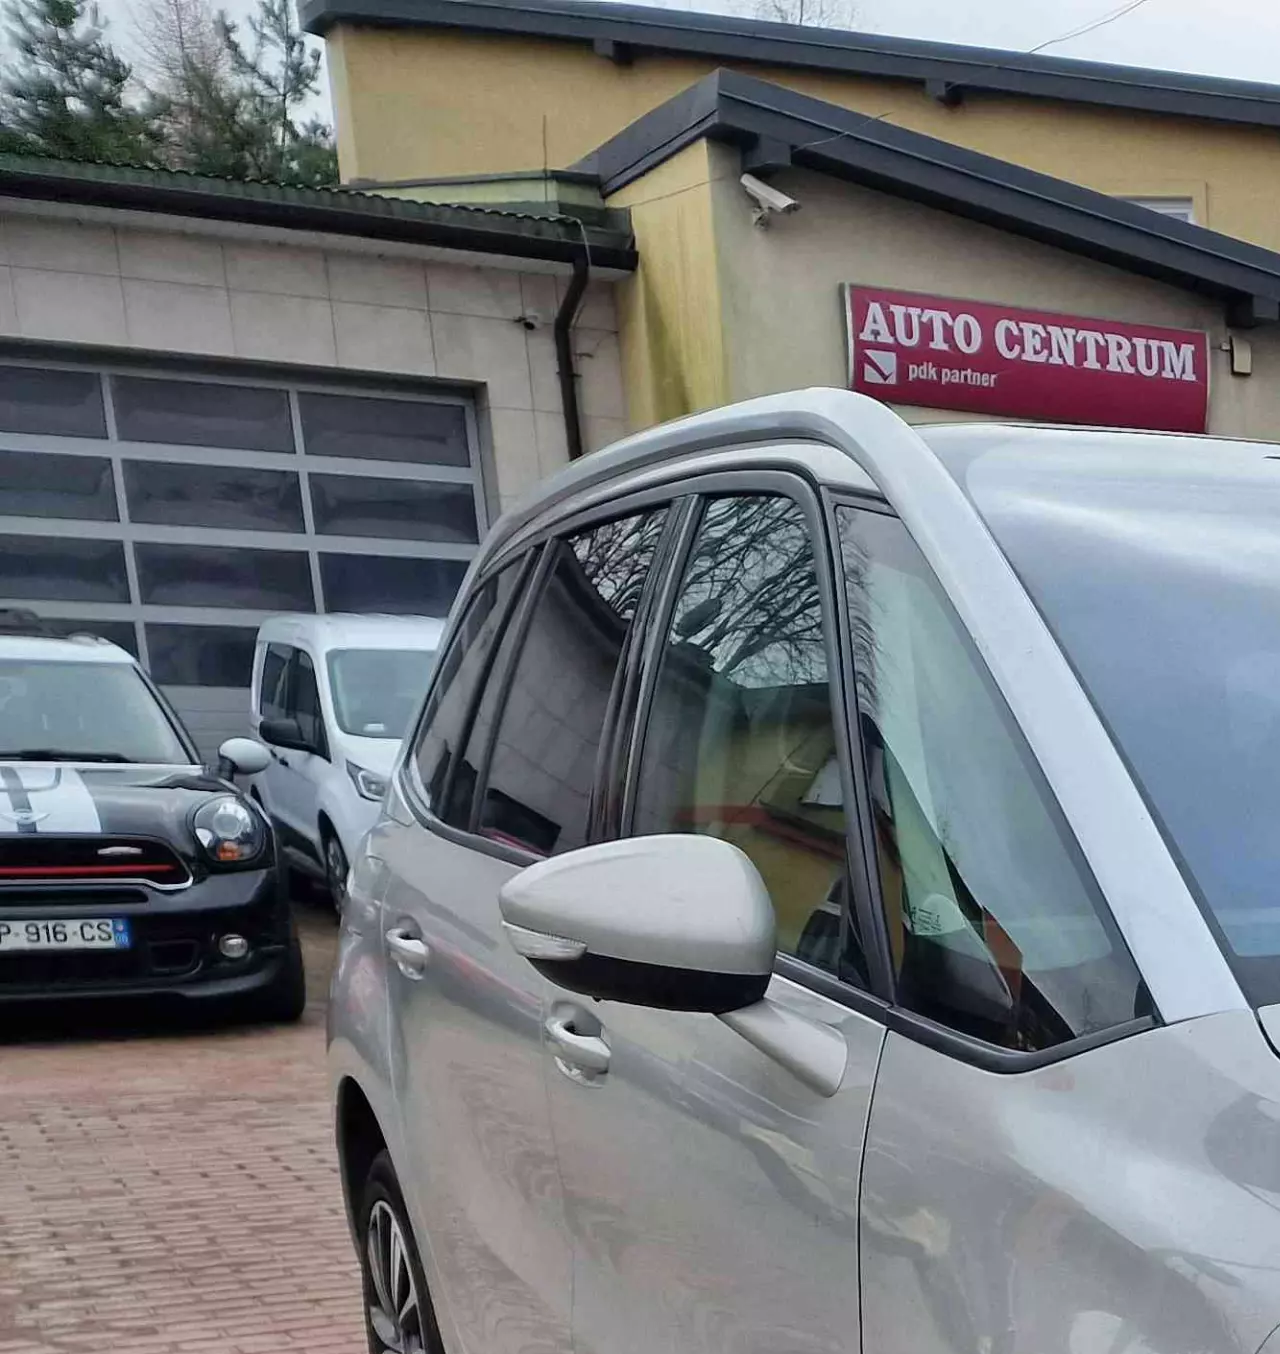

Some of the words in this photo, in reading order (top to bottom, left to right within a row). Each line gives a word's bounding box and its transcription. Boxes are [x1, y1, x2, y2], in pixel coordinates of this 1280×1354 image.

[859, 301, 983, 354] AUTO
[994, 318, 1198, 382] CENTRUM
[908, 363, 938, 384] pdk
[941, 366, 998, 388] partner
